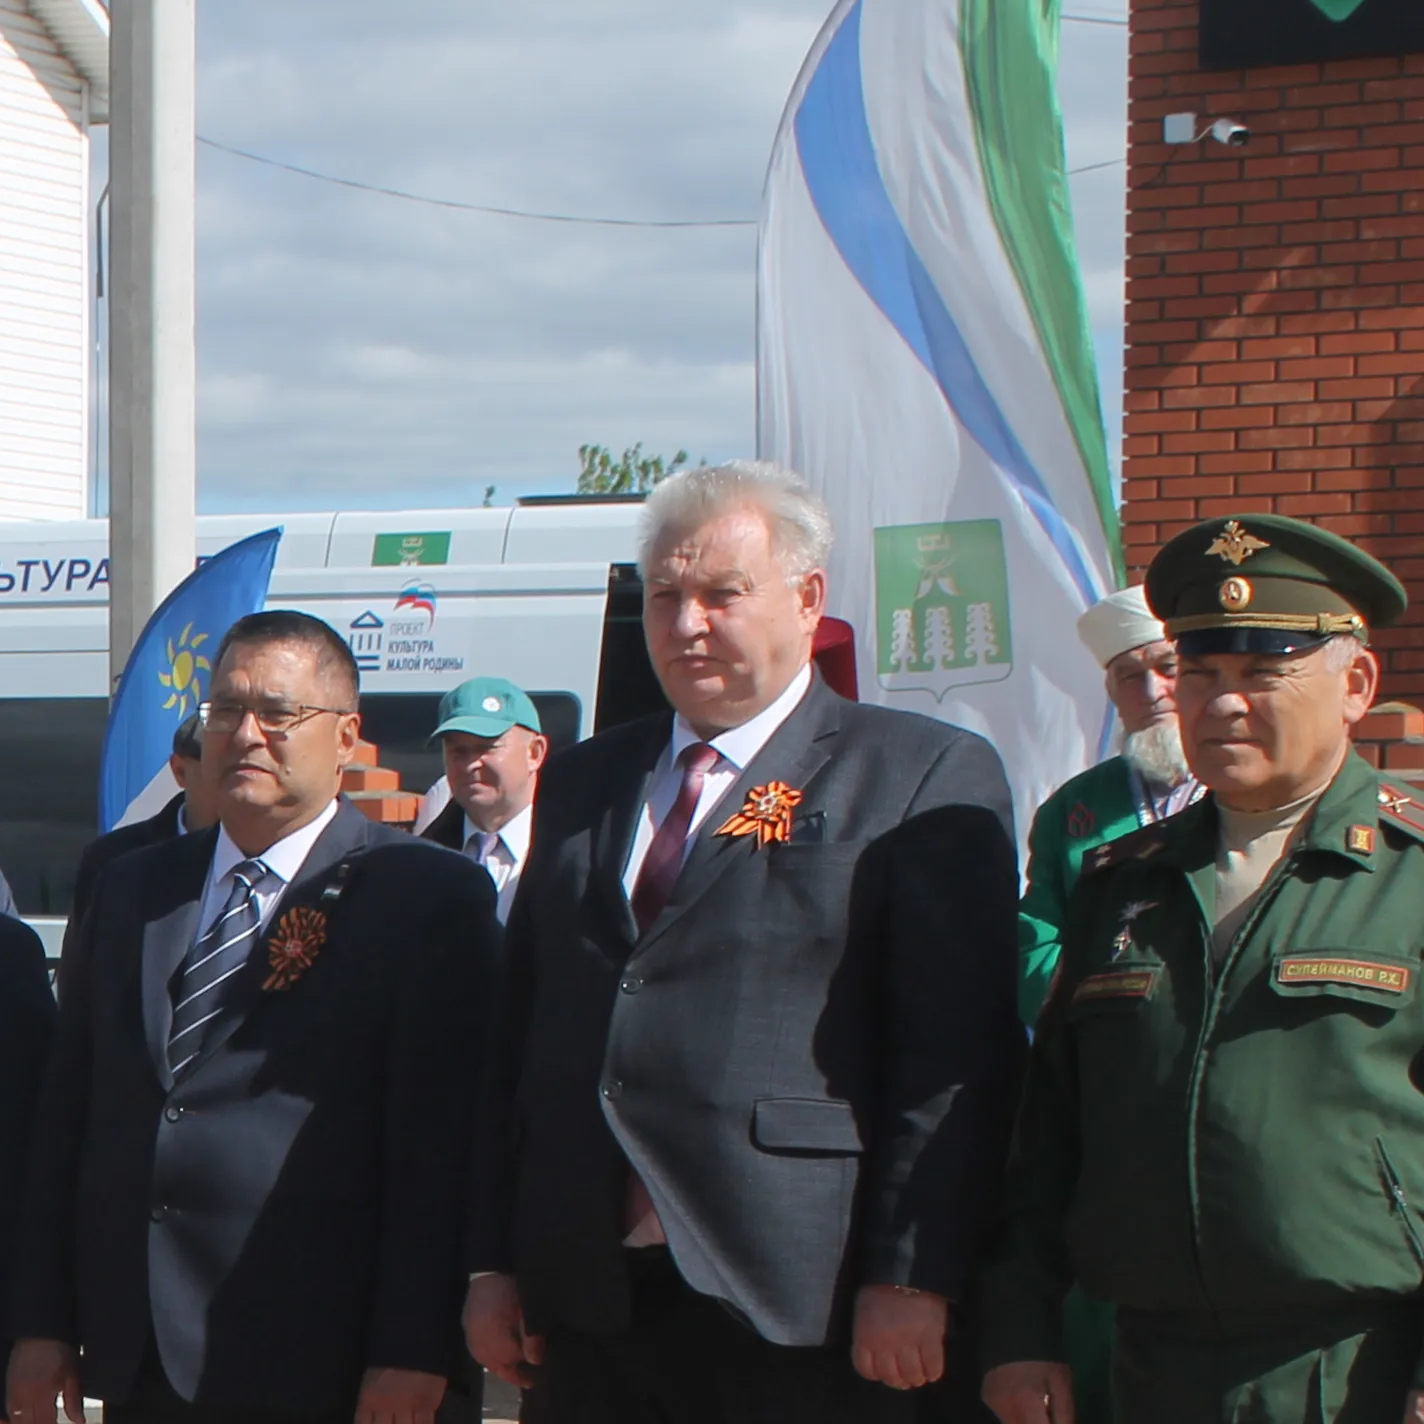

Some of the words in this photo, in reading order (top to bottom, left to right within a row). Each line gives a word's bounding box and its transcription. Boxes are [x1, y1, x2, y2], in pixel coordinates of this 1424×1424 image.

[389, 622, 424, 636] ПРОЕКТ
[387, 640, 435, 654] КУЛЬТУРА
[386, 655, 421, 671] МАЛОЙ
[422, 657, 464, 673] РОДИНЫ
[1285, 962, 1374, 981] СУЛЕЙМАНОВ
